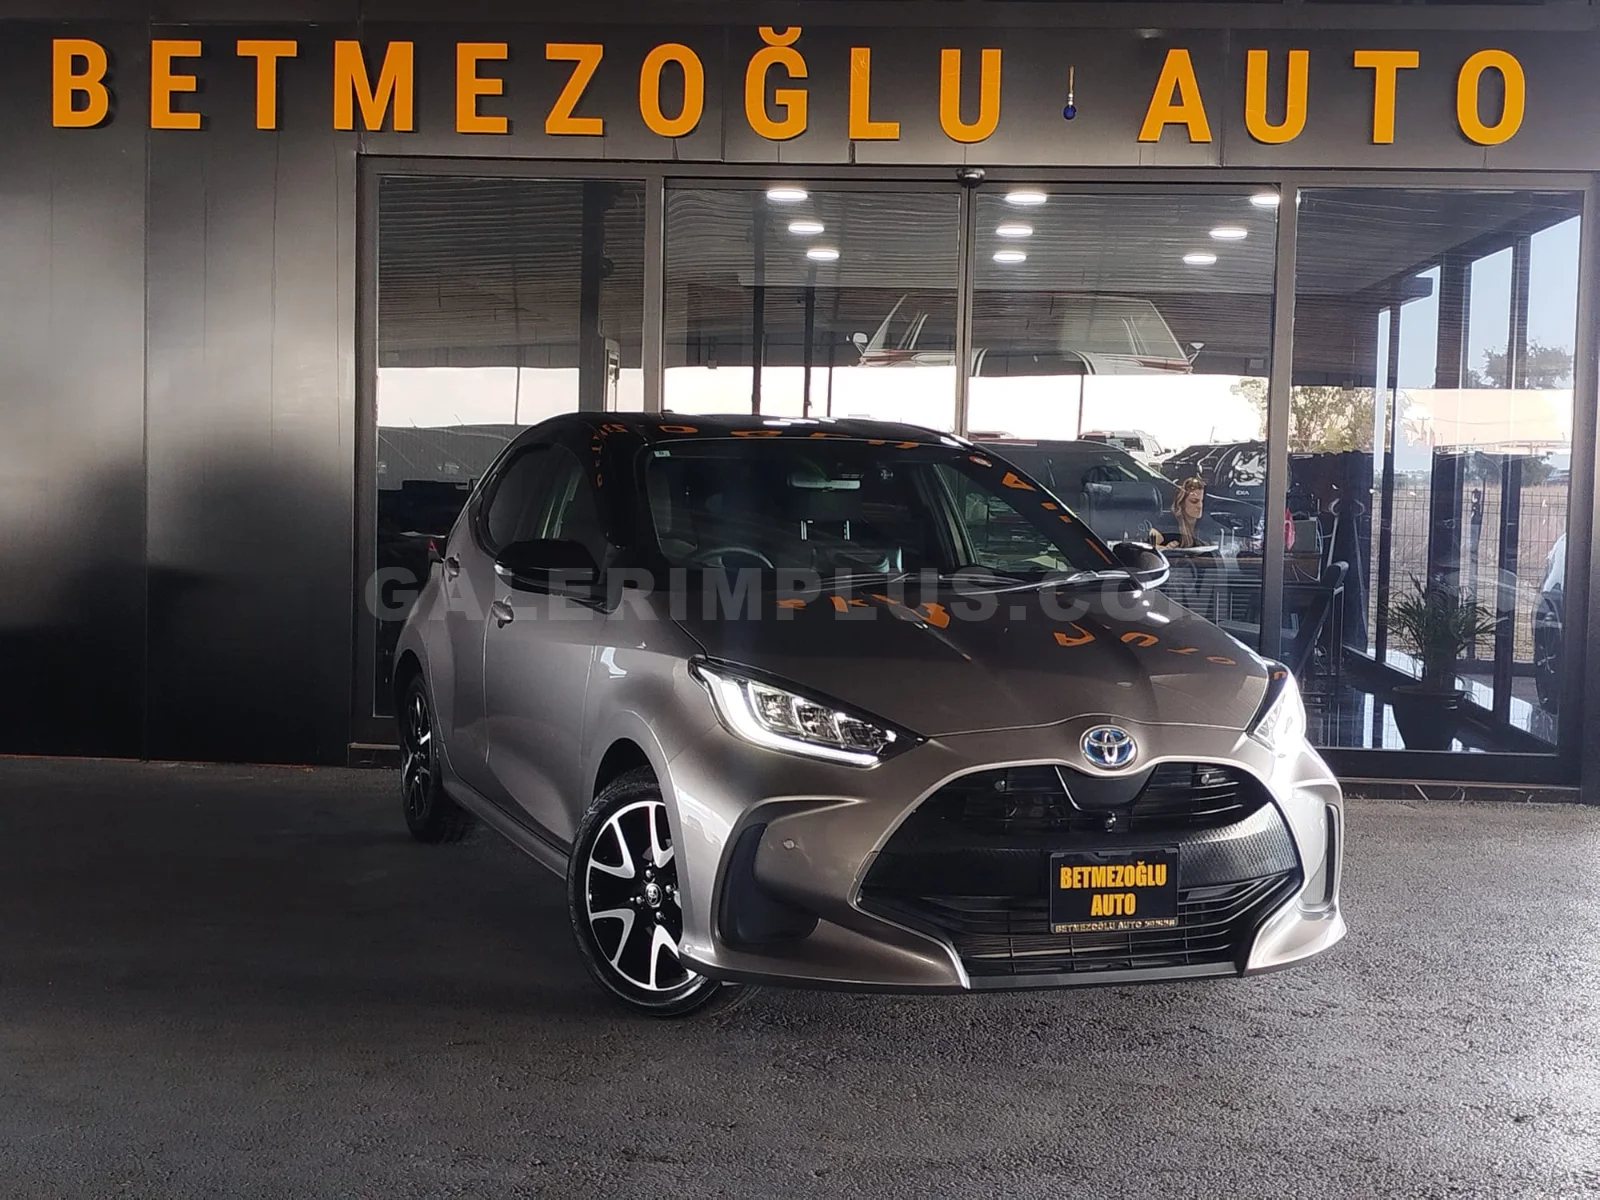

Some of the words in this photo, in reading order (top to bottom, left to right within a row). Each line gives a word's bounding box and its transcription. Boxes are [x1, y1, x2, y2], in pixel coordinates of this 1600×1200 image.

[51, 25, 1002, 143] BETMEZOĞLU
[1138, 48, 1526, 145] AUTO
[1060, 861, 1167, 888] BETMEZOĞLU
[1090, 893, 1137, 916] AUTO
[1117, 919, 1142, 930] AUTO
